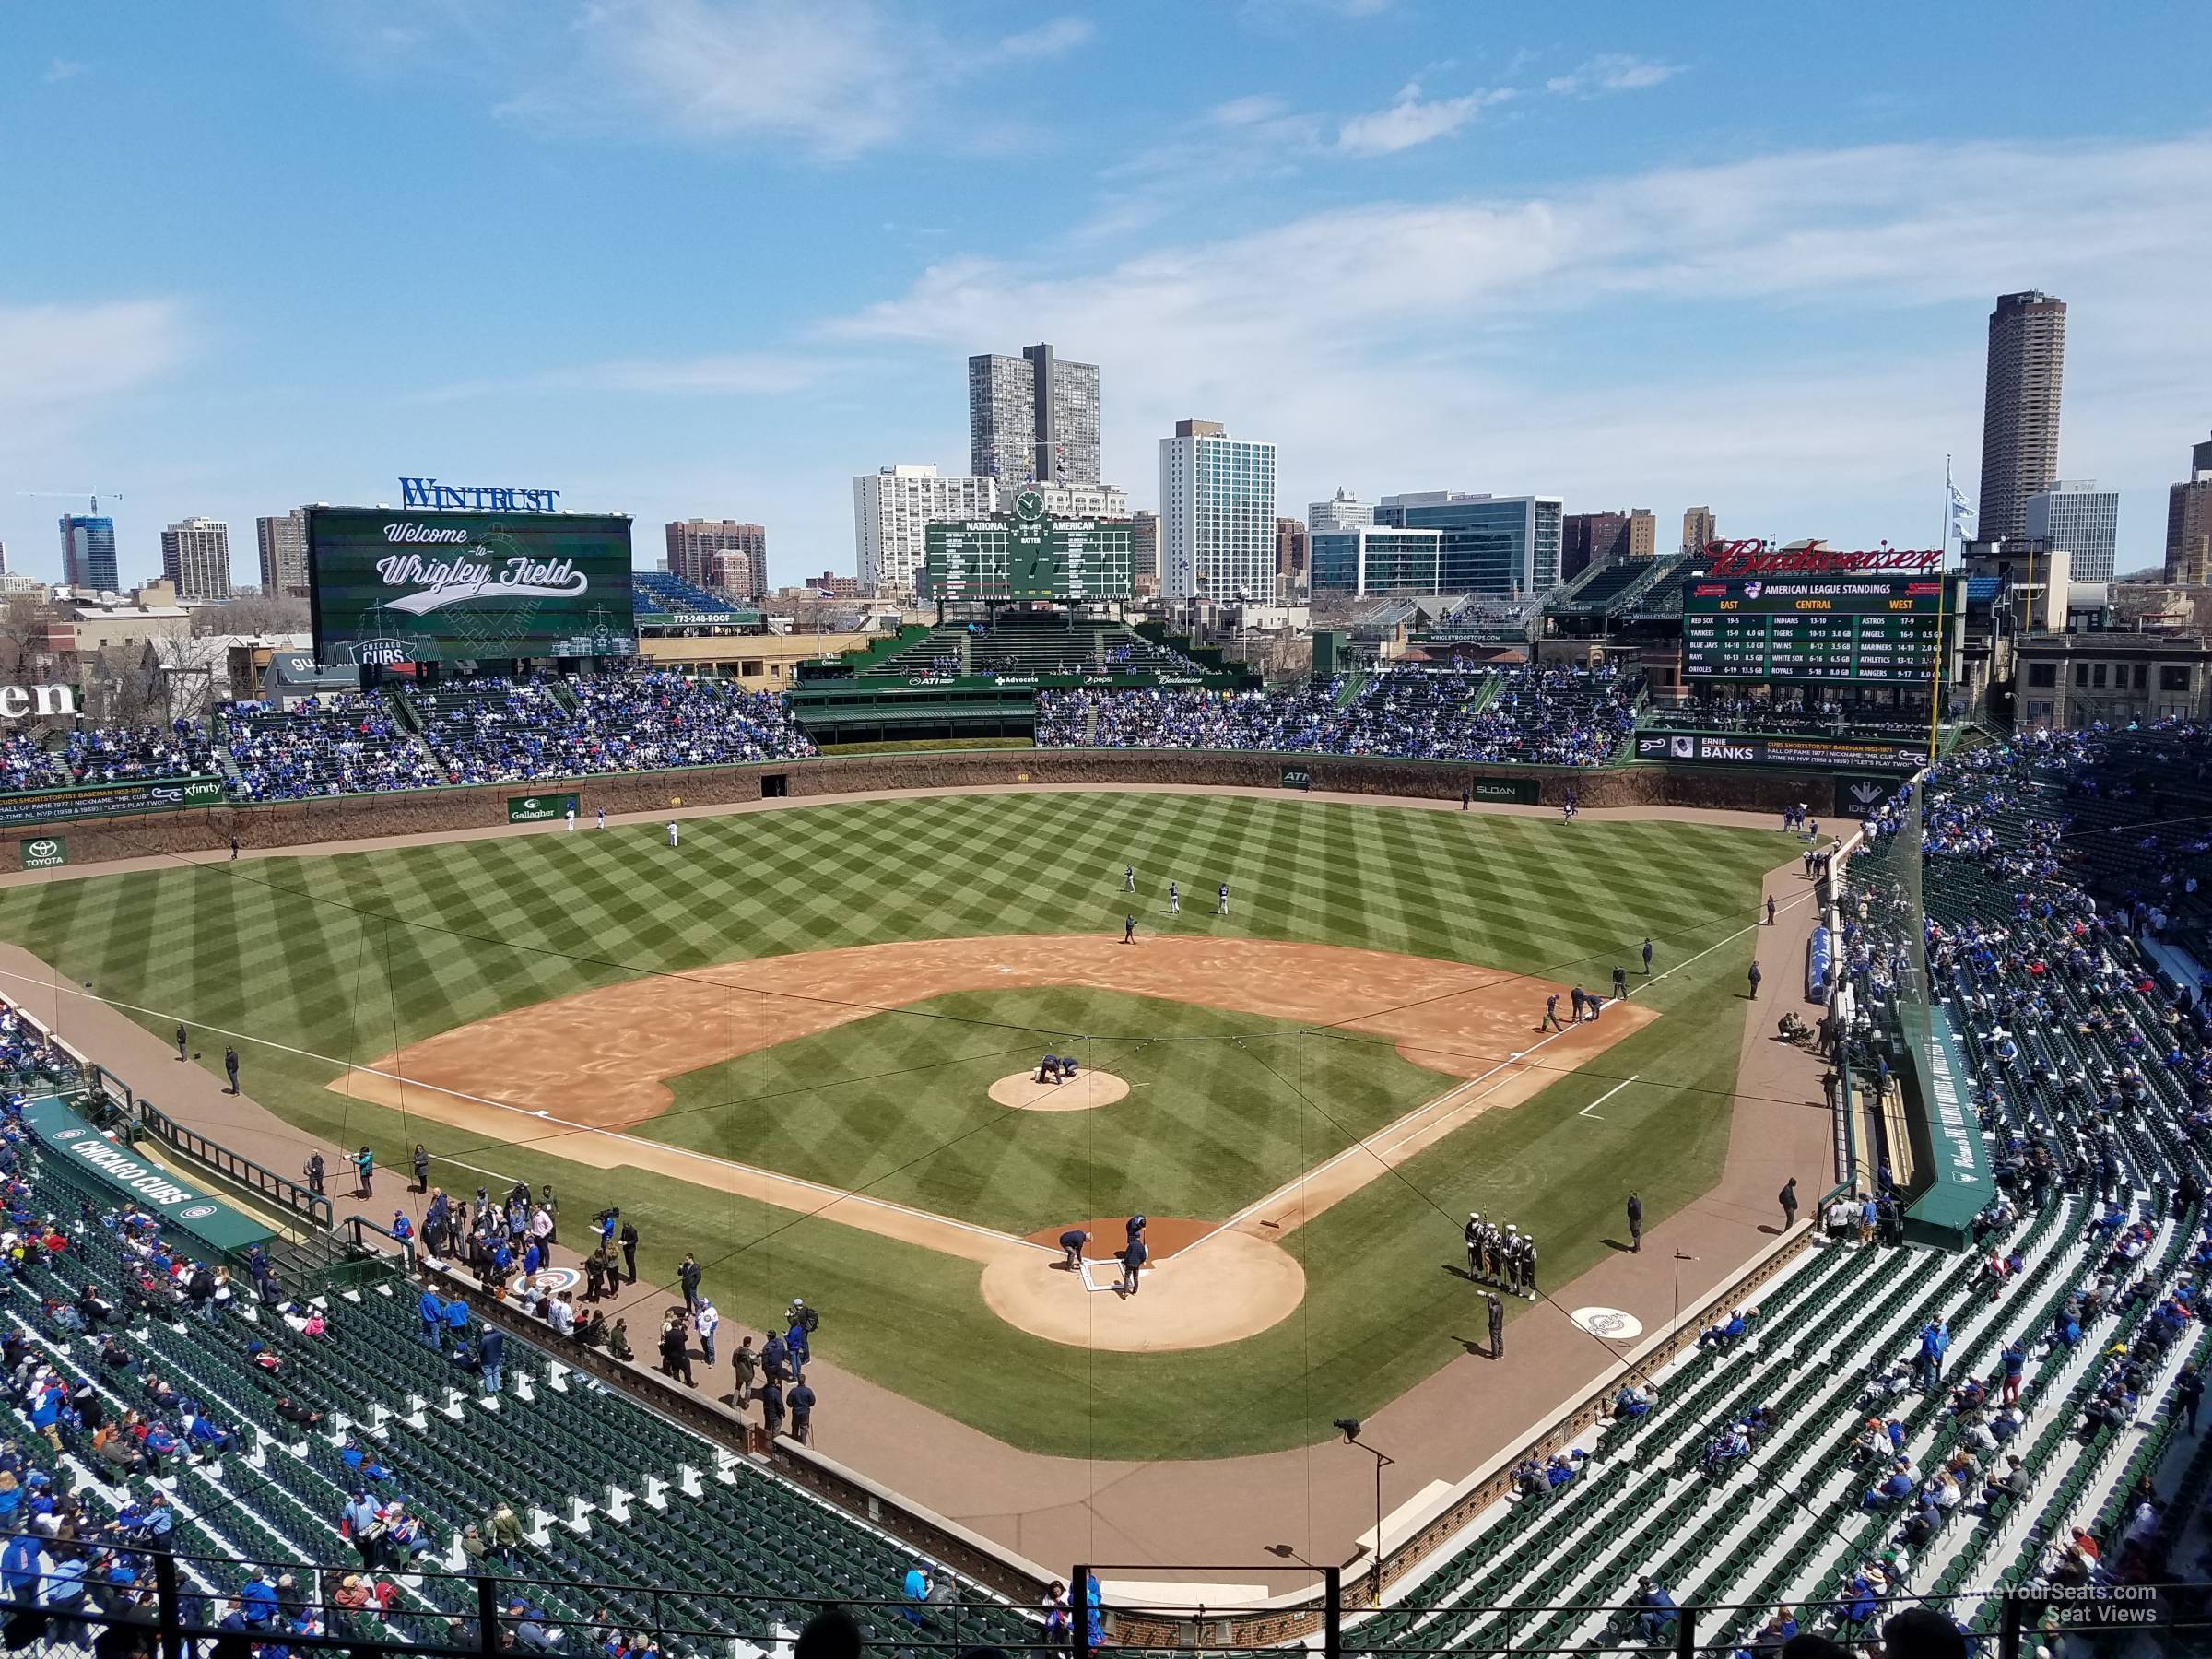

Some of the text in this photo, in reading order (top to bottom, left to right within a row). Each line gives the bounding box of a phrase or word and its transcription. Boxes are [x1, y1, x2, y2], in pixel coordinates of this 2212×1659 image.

[398, 477, 560, 512] WINTRUST
[966, 522, 1009, 531] NATIONAL
[1052, 522, 1095, 531] AMERICAN
[383, 523, 468, 543] Welcome
[1703, 538, 1945, 576] Budweiser
[376, 555, 573, 594] Wrigley Field
[1764, 584, 1891, 594] AMERICAN LEAGUE STANDINGS
[1720, 600, 1913, 609] EAST CENTRAL WEST
[674, 615, 730, 623] 773-248-ROOF
[362, 641, 401, 651] CHICAGO
[1092, 675, 1112, 684] pepsi
[1157, 675, 1204, 684] Budweiser
[1701, 737, 1726, 746] ERNIE
[1701, 746, 1754, 759] BANKS
[184, 782, 221, 797] xfinity
[1476, 785, 1517, 795] SLOAN
[75, 797, 113, 805] NICKNAME:
[512, 808, 555, 820] Gallagher
[25, 856, 64, 867] TOYOTA
[70, 1140, 193, 1205] CHICAGO CUBS
